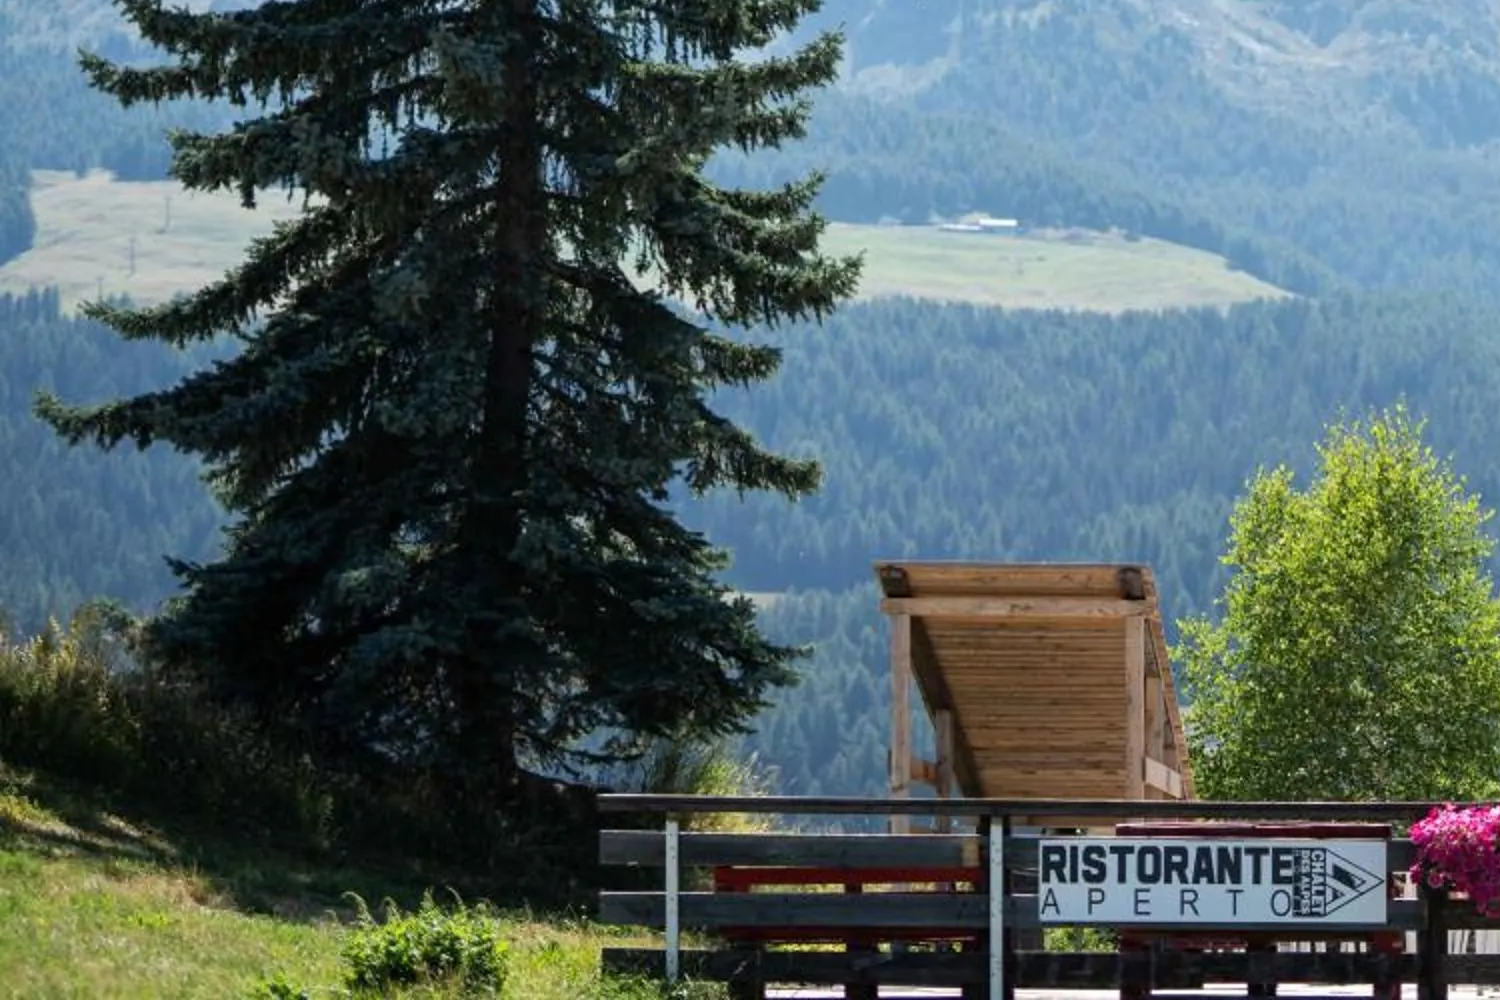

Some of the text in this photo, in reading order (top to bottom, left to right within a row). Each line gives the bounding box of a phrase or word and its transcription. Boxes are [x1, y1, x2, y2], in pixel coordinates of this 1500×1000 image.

[1041, 846, 1293, 884] RISTORANTE
[1311, 850, 1325, 914] CHALET
[1041, 889, 1291, 917] APERTO
